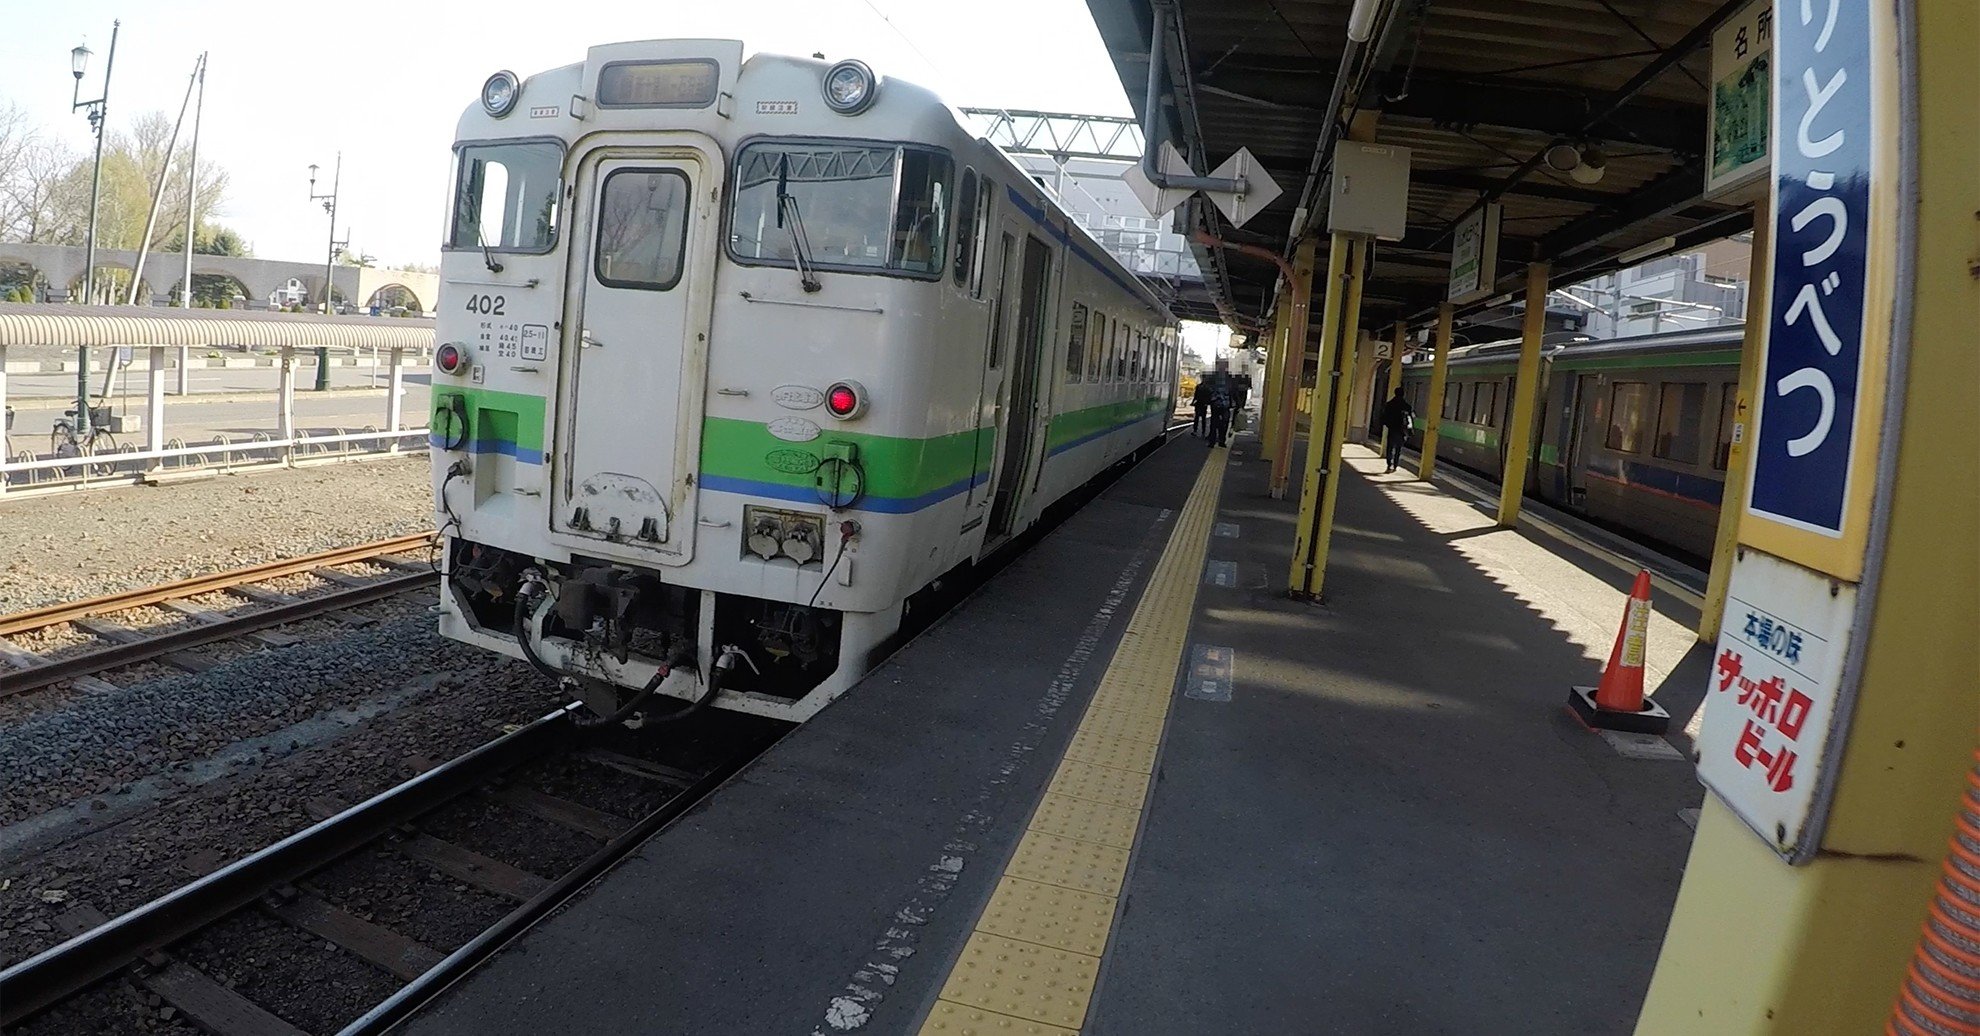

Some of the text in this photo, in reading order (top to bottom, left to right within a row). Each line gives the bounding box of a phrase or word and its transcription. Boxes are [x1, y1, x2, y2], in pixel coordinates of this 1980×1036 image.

[466, 294, 505, 315] 402
[1378, 344, 1389, 357] 2
[1743, 610, 1803, 666] 本場の味
[1718, 648, 1815, 742] サッポロ
[1735, 718, 1799, 793] ビール
